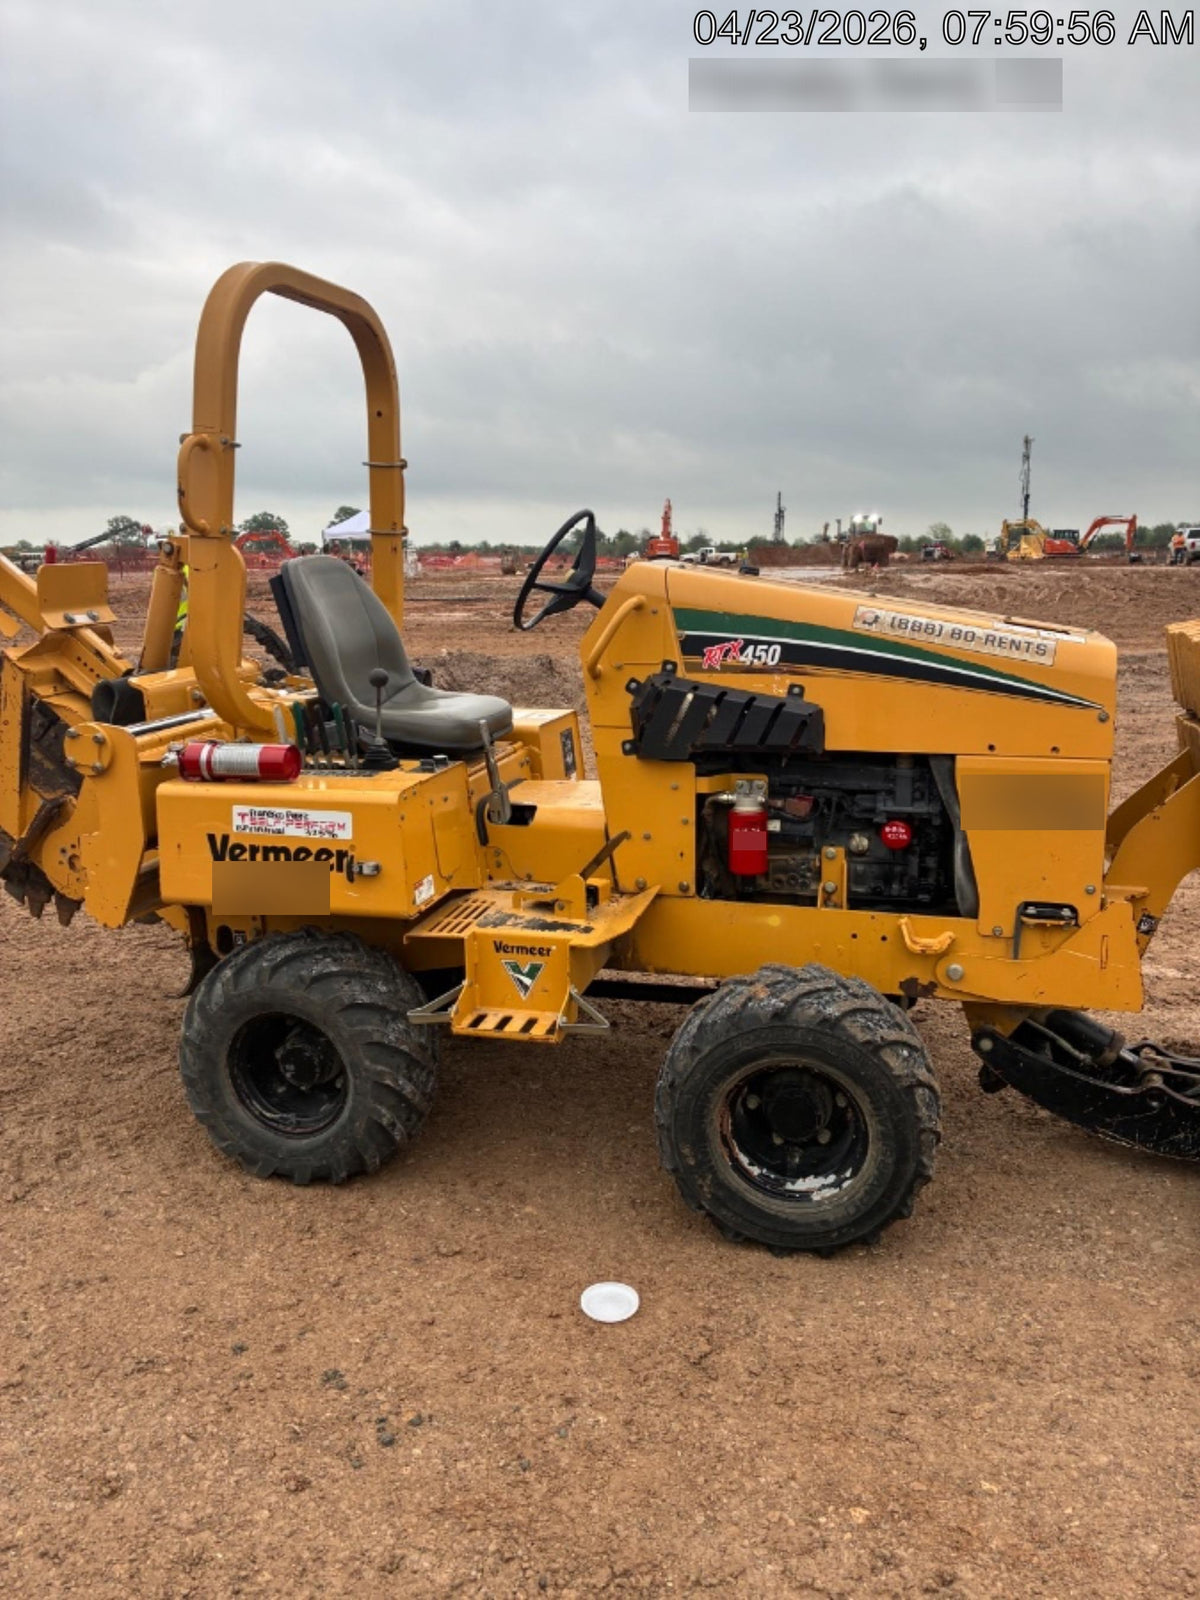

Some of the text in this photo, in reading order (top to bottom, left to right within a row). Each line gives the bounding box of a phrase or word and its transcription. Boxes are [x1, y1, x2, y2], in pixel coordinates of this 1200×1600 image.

[702, 638, 782, 671] RTX 450
[949, 627, 1049, 658] 80-RENTS
[493, 940, 552, 957] Vermeer
